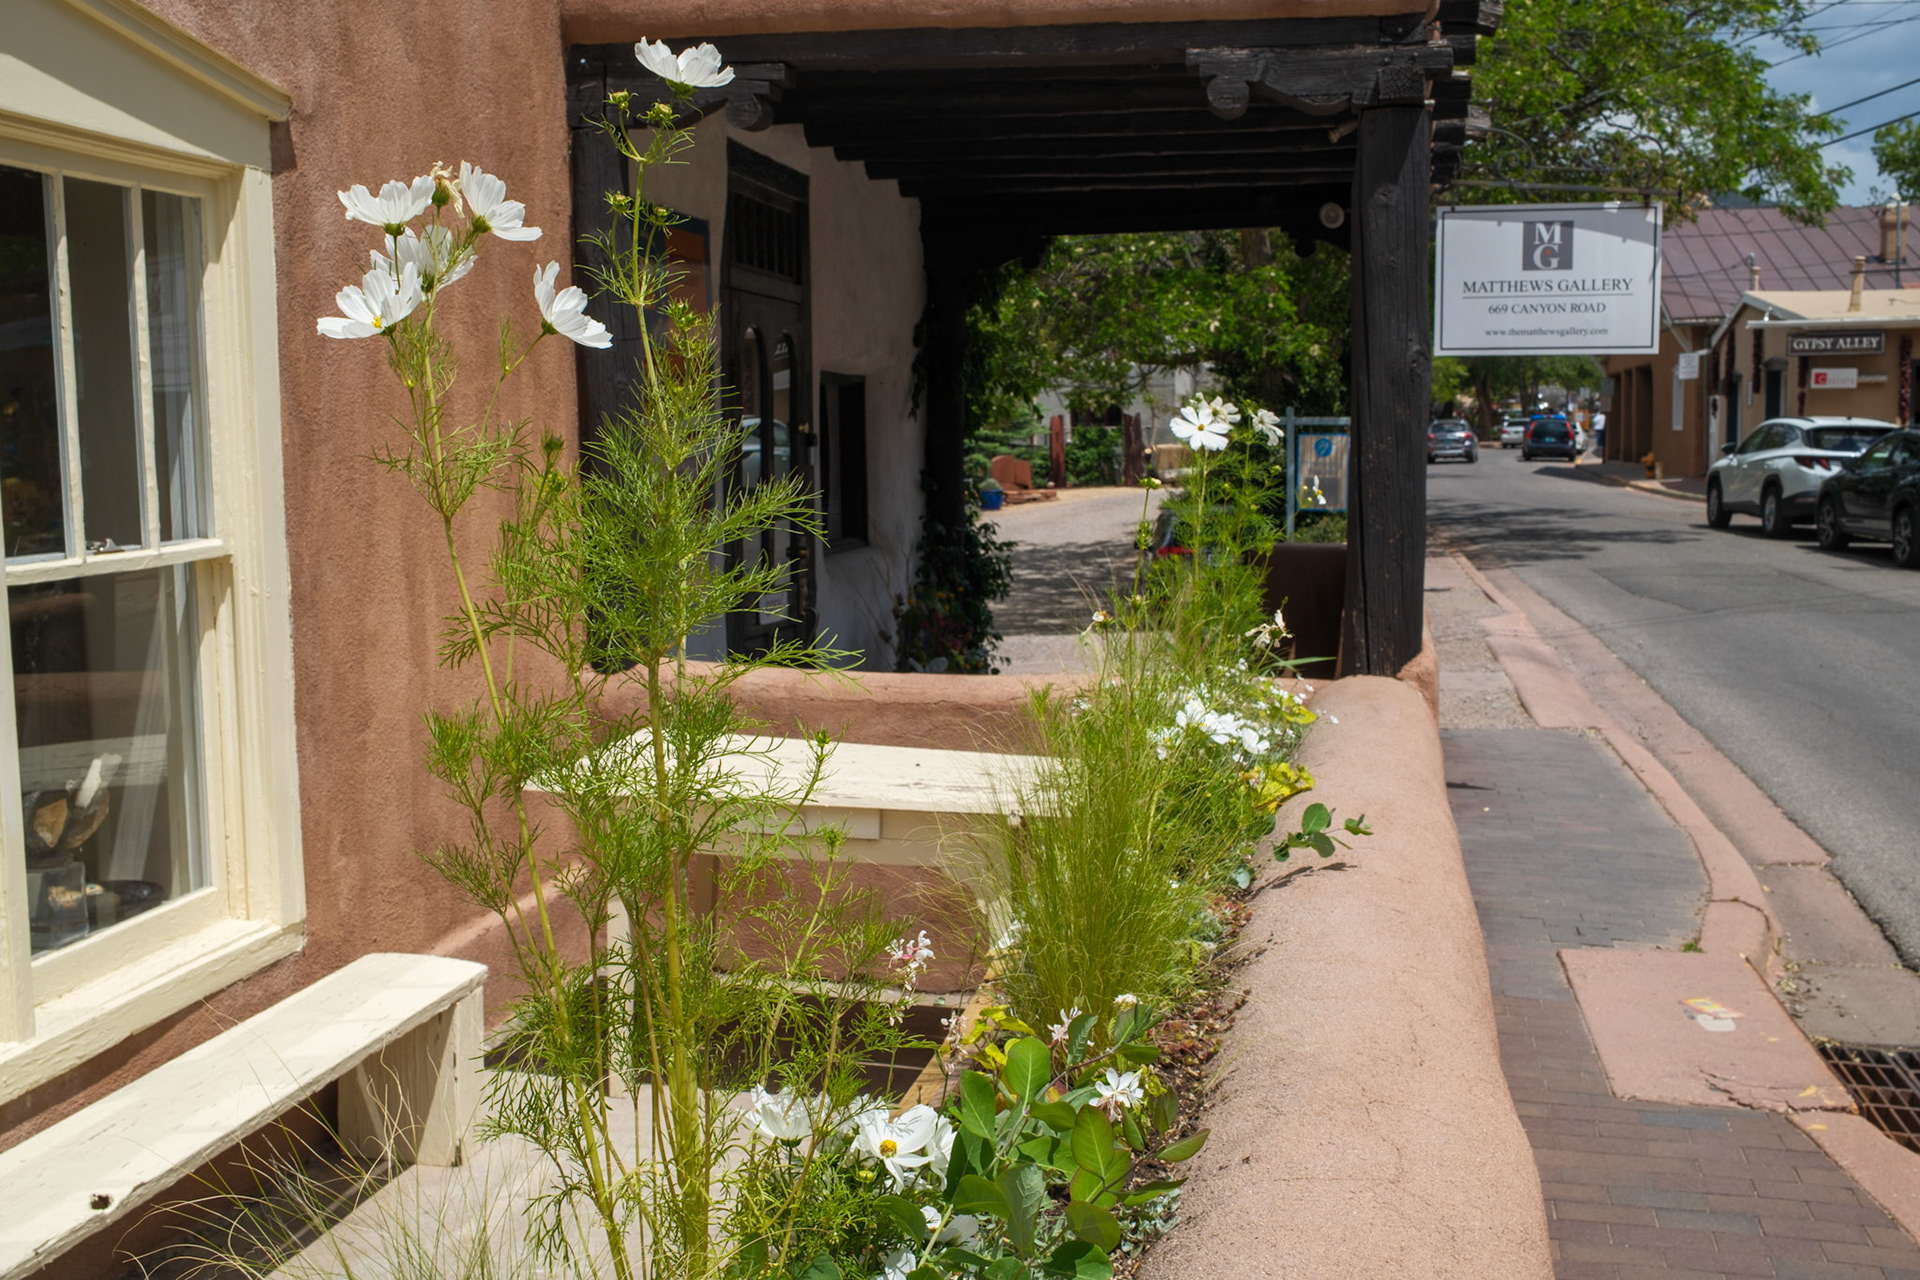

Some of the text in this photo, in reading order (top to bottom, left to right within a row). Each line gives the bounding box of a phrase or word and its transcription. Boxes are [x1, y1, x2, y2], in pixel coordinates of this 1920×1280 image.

[1533, 222, 1562, 245] M
[1533, 244, 1560, 270] G
[1462, 278, 1633, 294] MATTHEWS GALLERY
[1488, 302, 1606, 315] 669 CANYON ROAD
[1484, 326, 1608, 337] www.thematthewsgallery.com
[1792, 336, 1880, 350] GYPSY ALLEY
